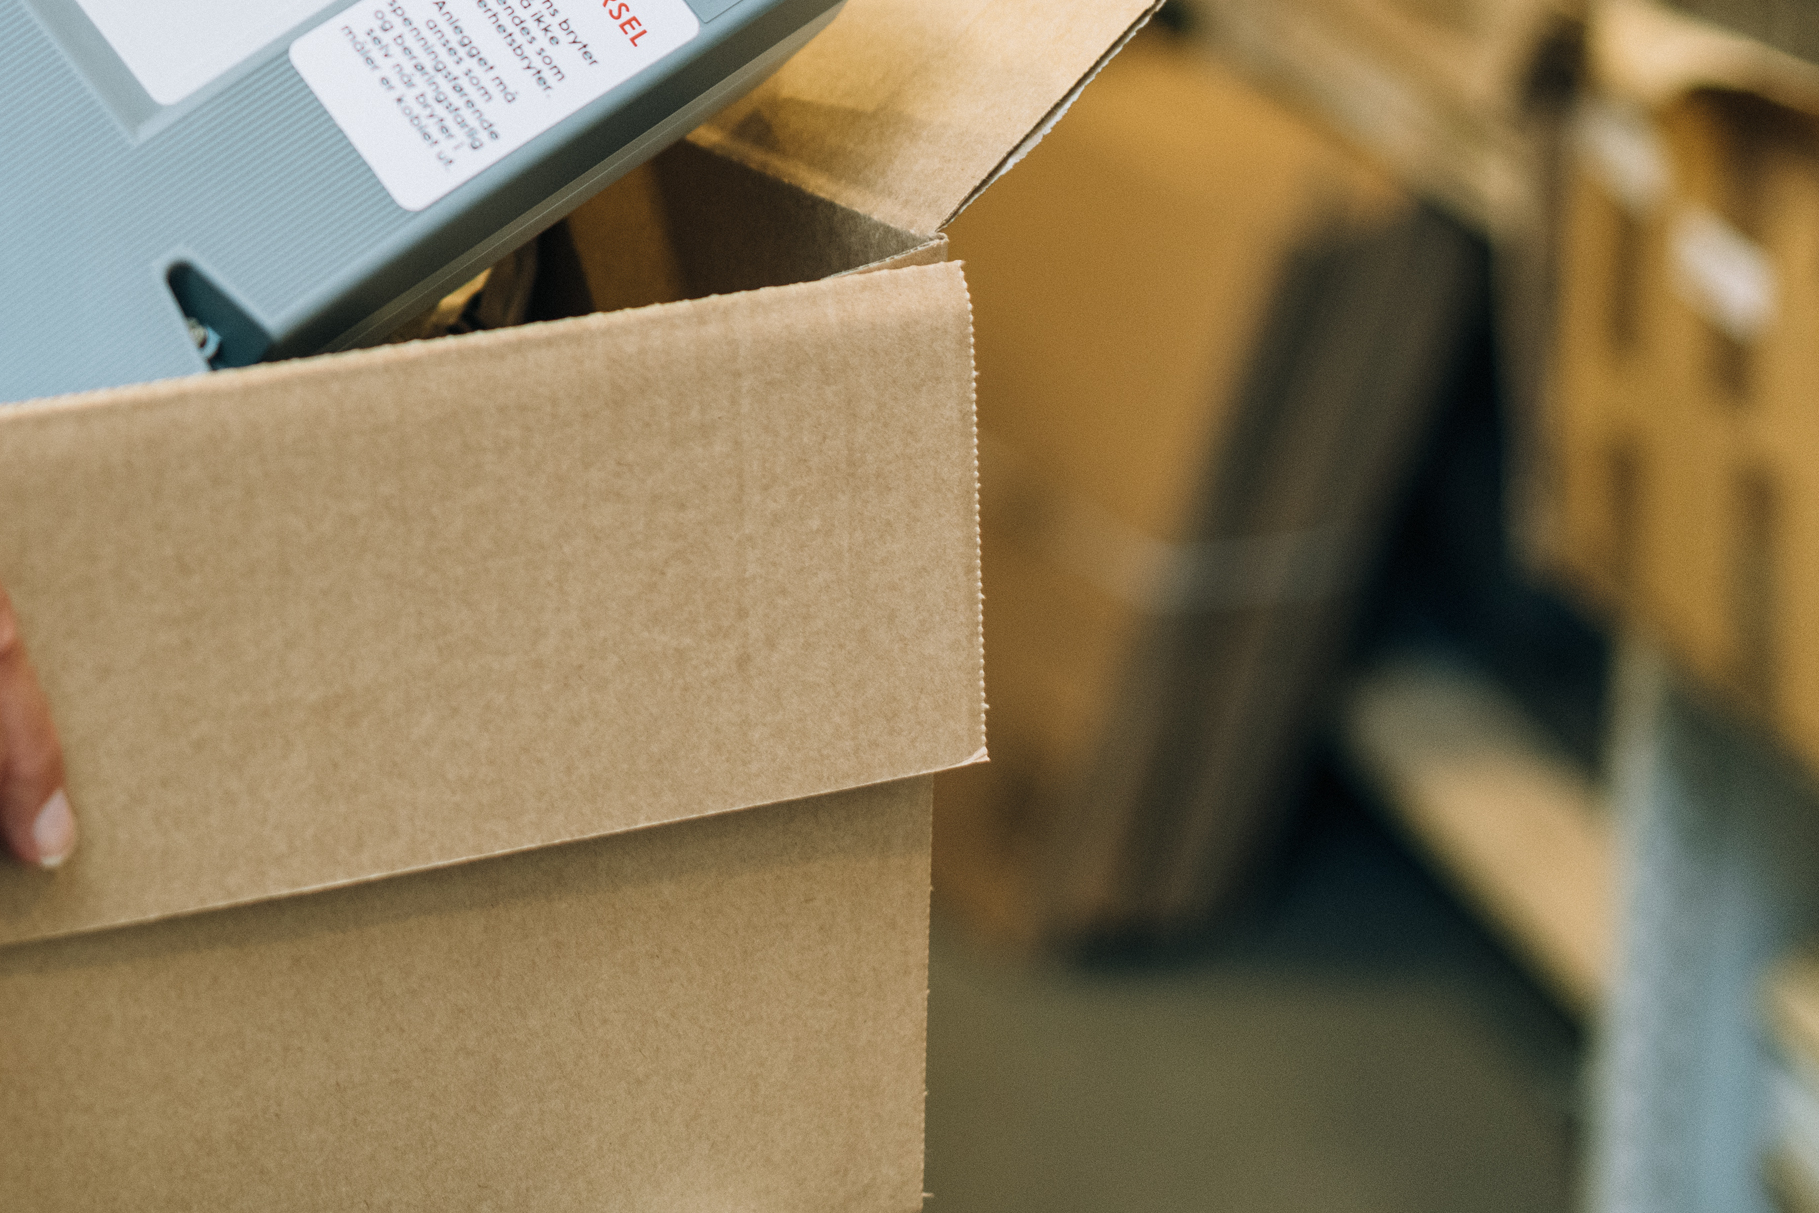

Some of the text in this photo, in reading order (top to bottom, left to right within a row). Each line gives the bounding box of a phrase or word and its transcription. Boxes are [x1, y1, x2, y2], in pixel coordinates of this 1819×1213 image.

[426, 19, 492, 102] anses som
[432, 0, 518, 103] Anlegget må
[530, 12, 560, 45] ikke
[536, 47, 565, 81] som
[557, 18, 599, 66] bryter
[341, 24, 381, 70] måler
[380, 76, 394, 90] er
[395, 95, 439, 146] koblet
[366, 28, 392, 58] selv
[392, 62, 417, 89] når
[414, 93, 454, 139] bryter
[373, 10, 484, 150] og berøringsfarlig
